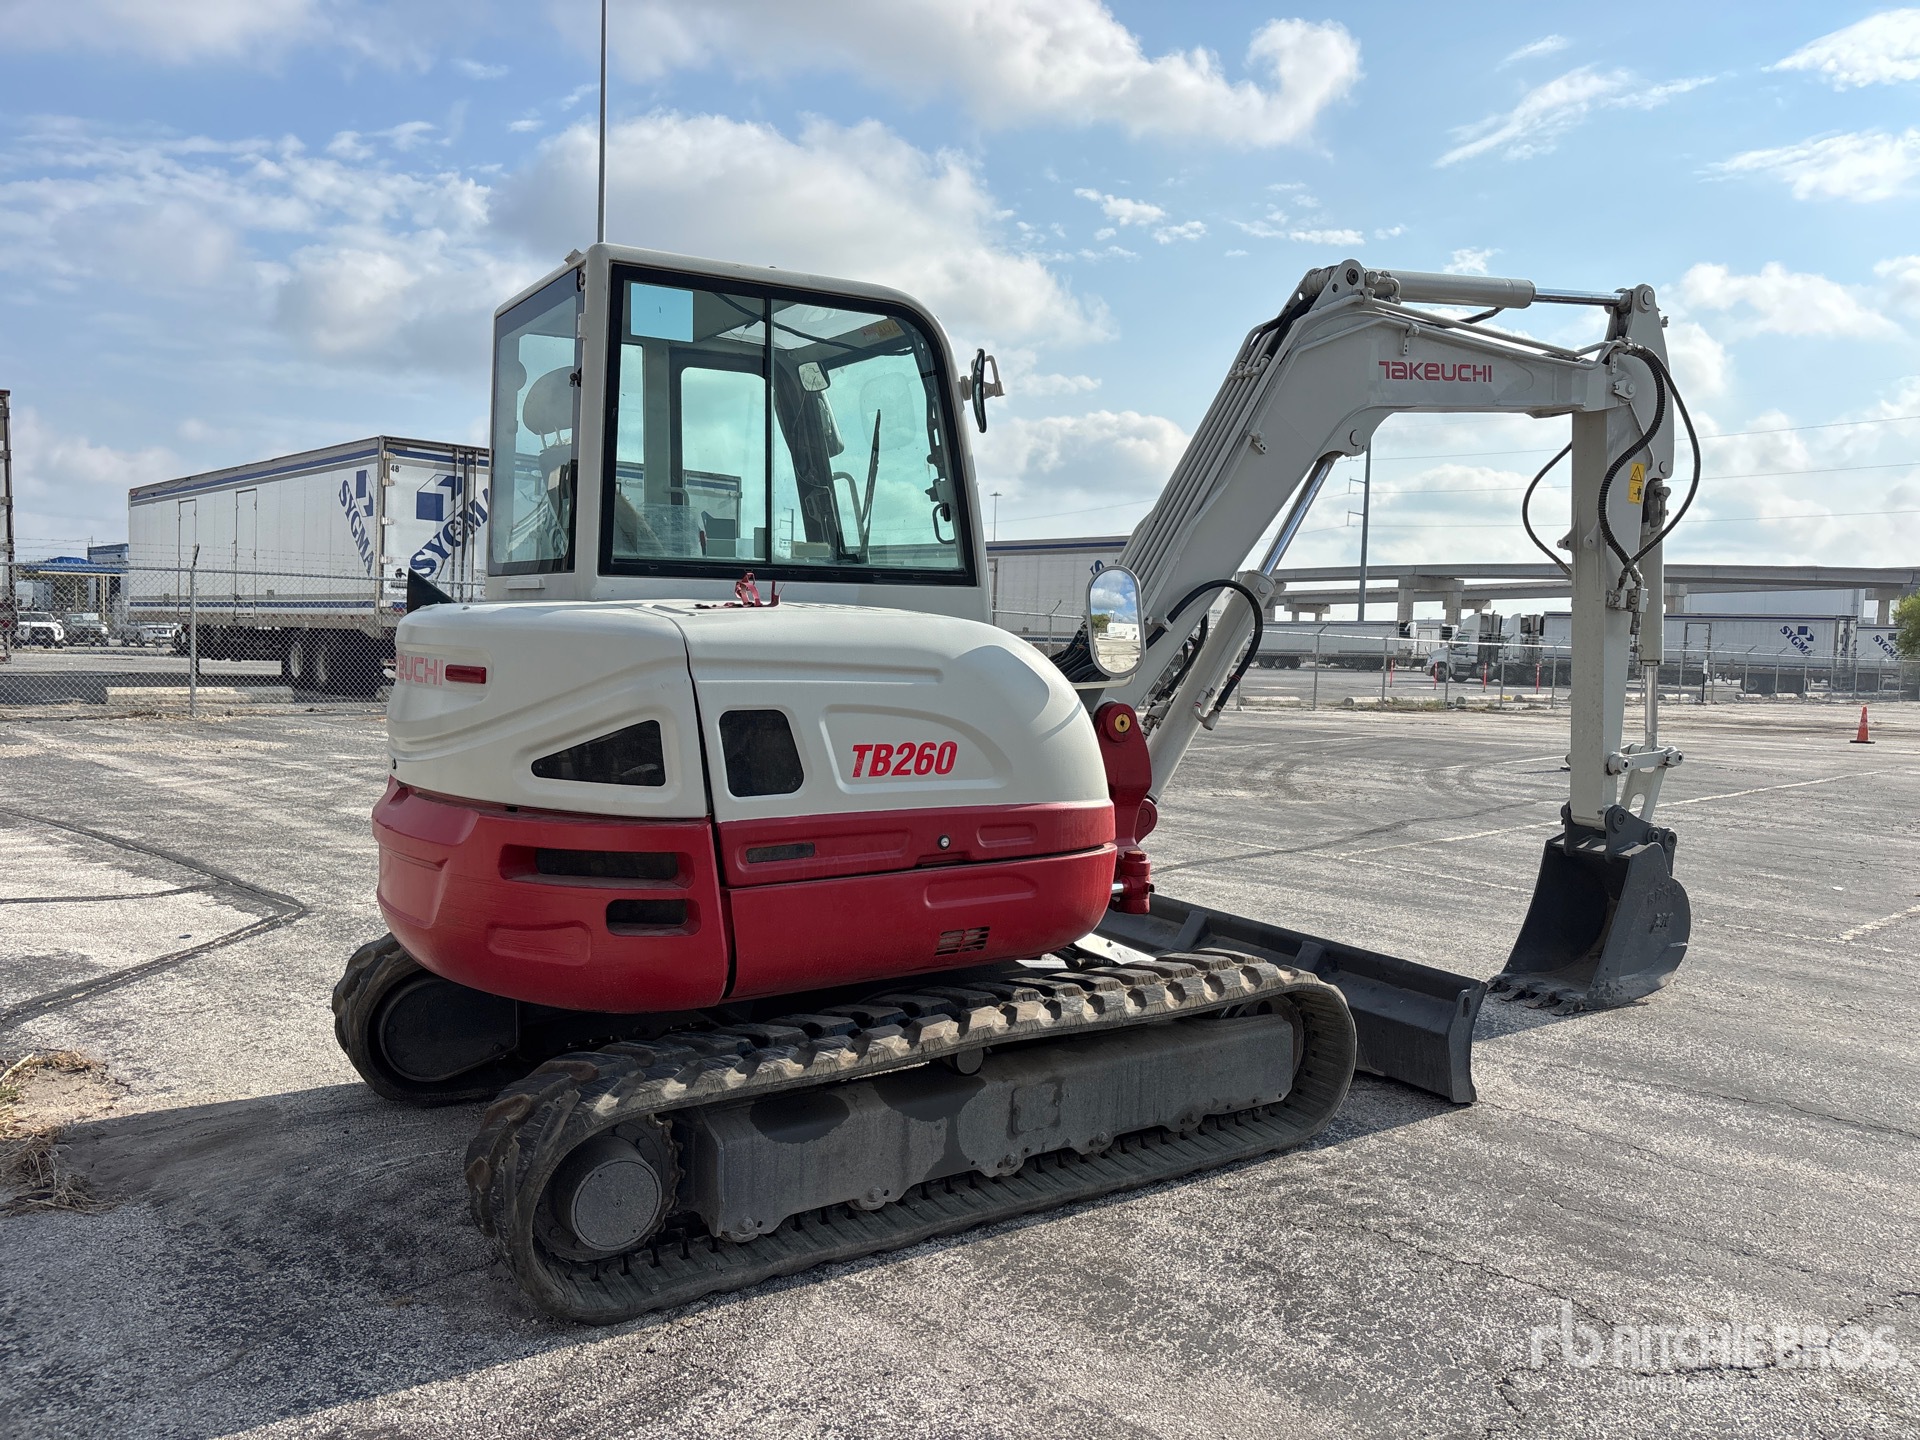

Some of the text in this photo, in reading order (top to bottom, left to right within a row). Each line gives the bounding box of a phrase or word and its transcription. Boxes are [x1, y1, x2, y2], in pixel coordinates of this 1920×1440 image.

[338, 479, 374, 577] SYGMA
[410, 487, 489, 579] SYGM
[1780, 625, 1813, 656] SYGMA
[852, 741, 958, 778] TB260
